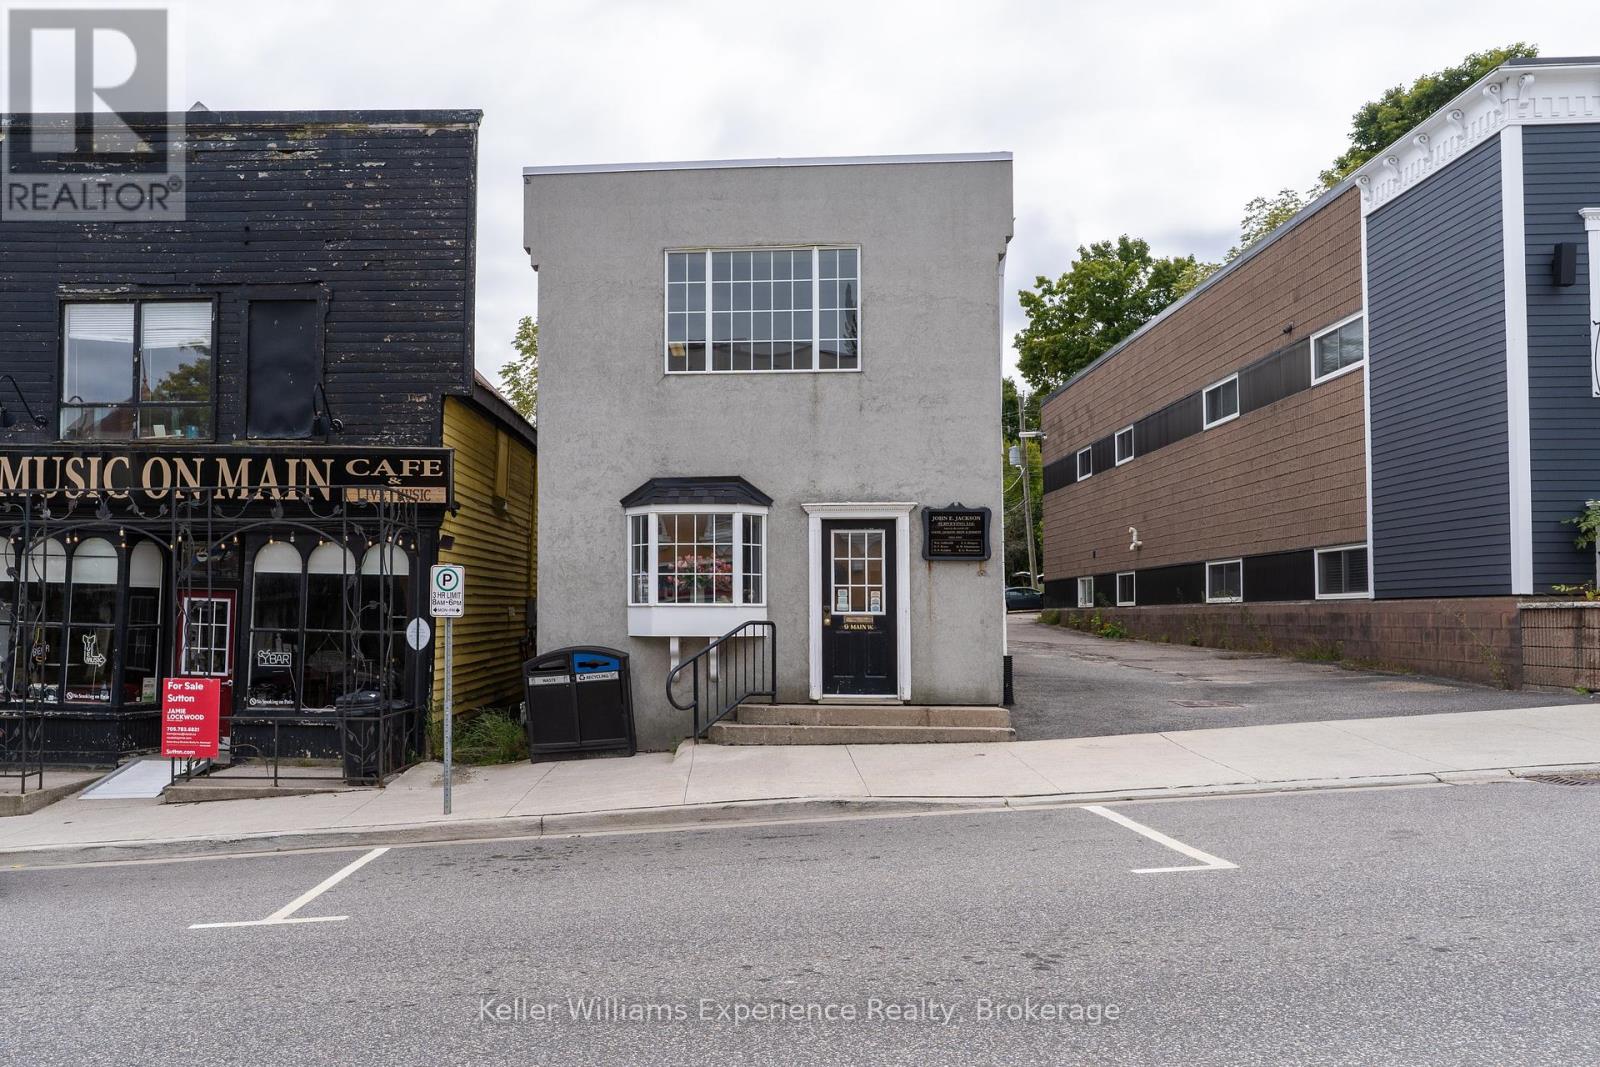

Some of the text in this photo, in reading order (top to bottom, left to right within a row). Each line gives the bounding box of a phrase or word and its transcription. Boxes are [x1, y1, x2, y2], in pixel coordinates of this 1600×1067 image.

[345, 458, 444, 477] CAFE
[0, 456, 335, 501] MUSIC ON MAIN
[387, 476, 403, 485] &
[442, 573, 453, 587] P
[432, 591, 462, 599] 3 HR LIMIT
[269, 654, 290, 665] BAR
[168, 682, 204, 690] For Sale
[167, 694, 195, 703] Sutton
